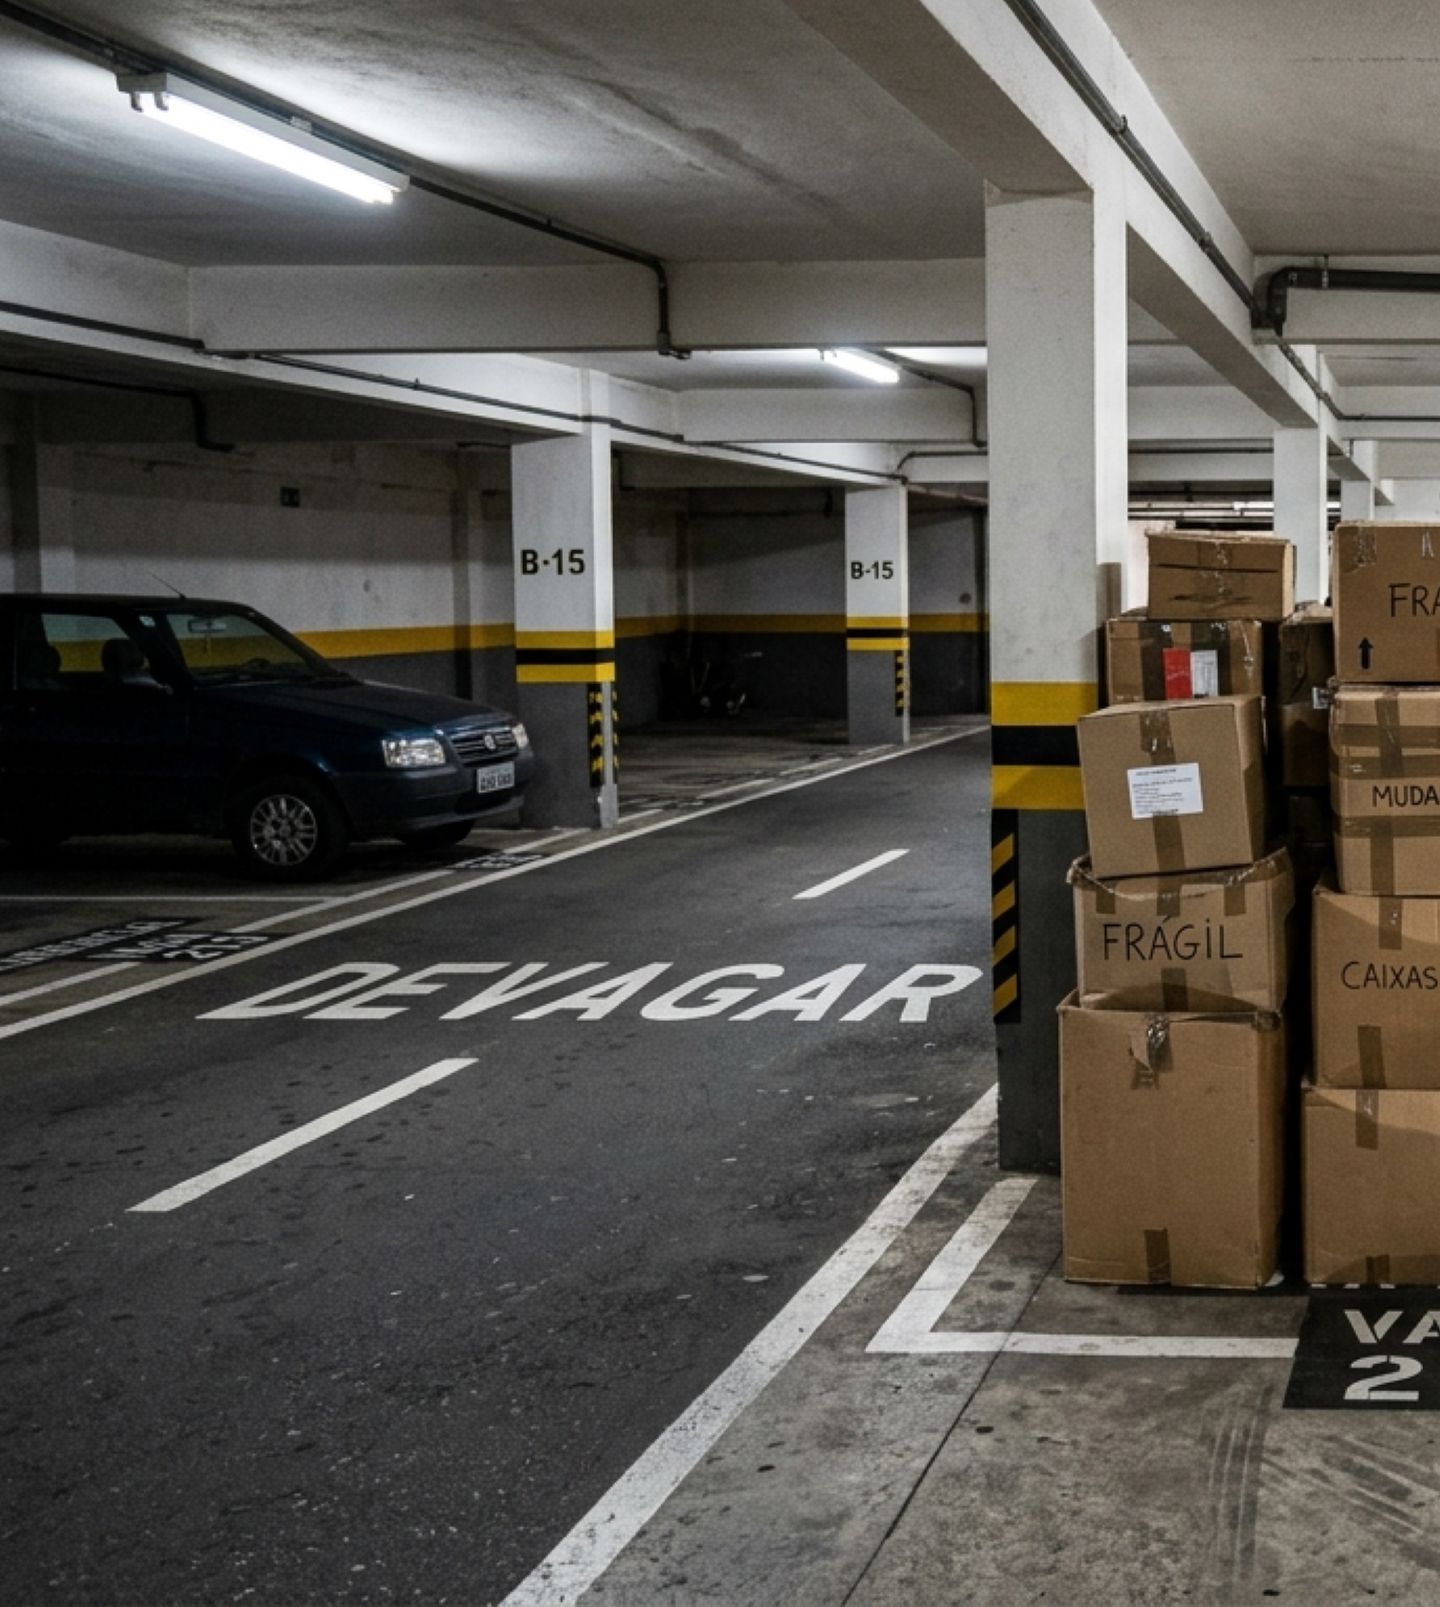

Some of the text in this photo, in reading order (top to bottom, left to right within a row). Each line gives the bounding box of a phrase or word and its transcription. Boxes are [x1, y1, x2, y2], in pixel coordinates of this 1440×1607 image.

[850, 560, 894, 580] B-15
[1340, 961, 1439, 990] CAIXAS
[195, 961, 985, 1023] DEVAGAR
